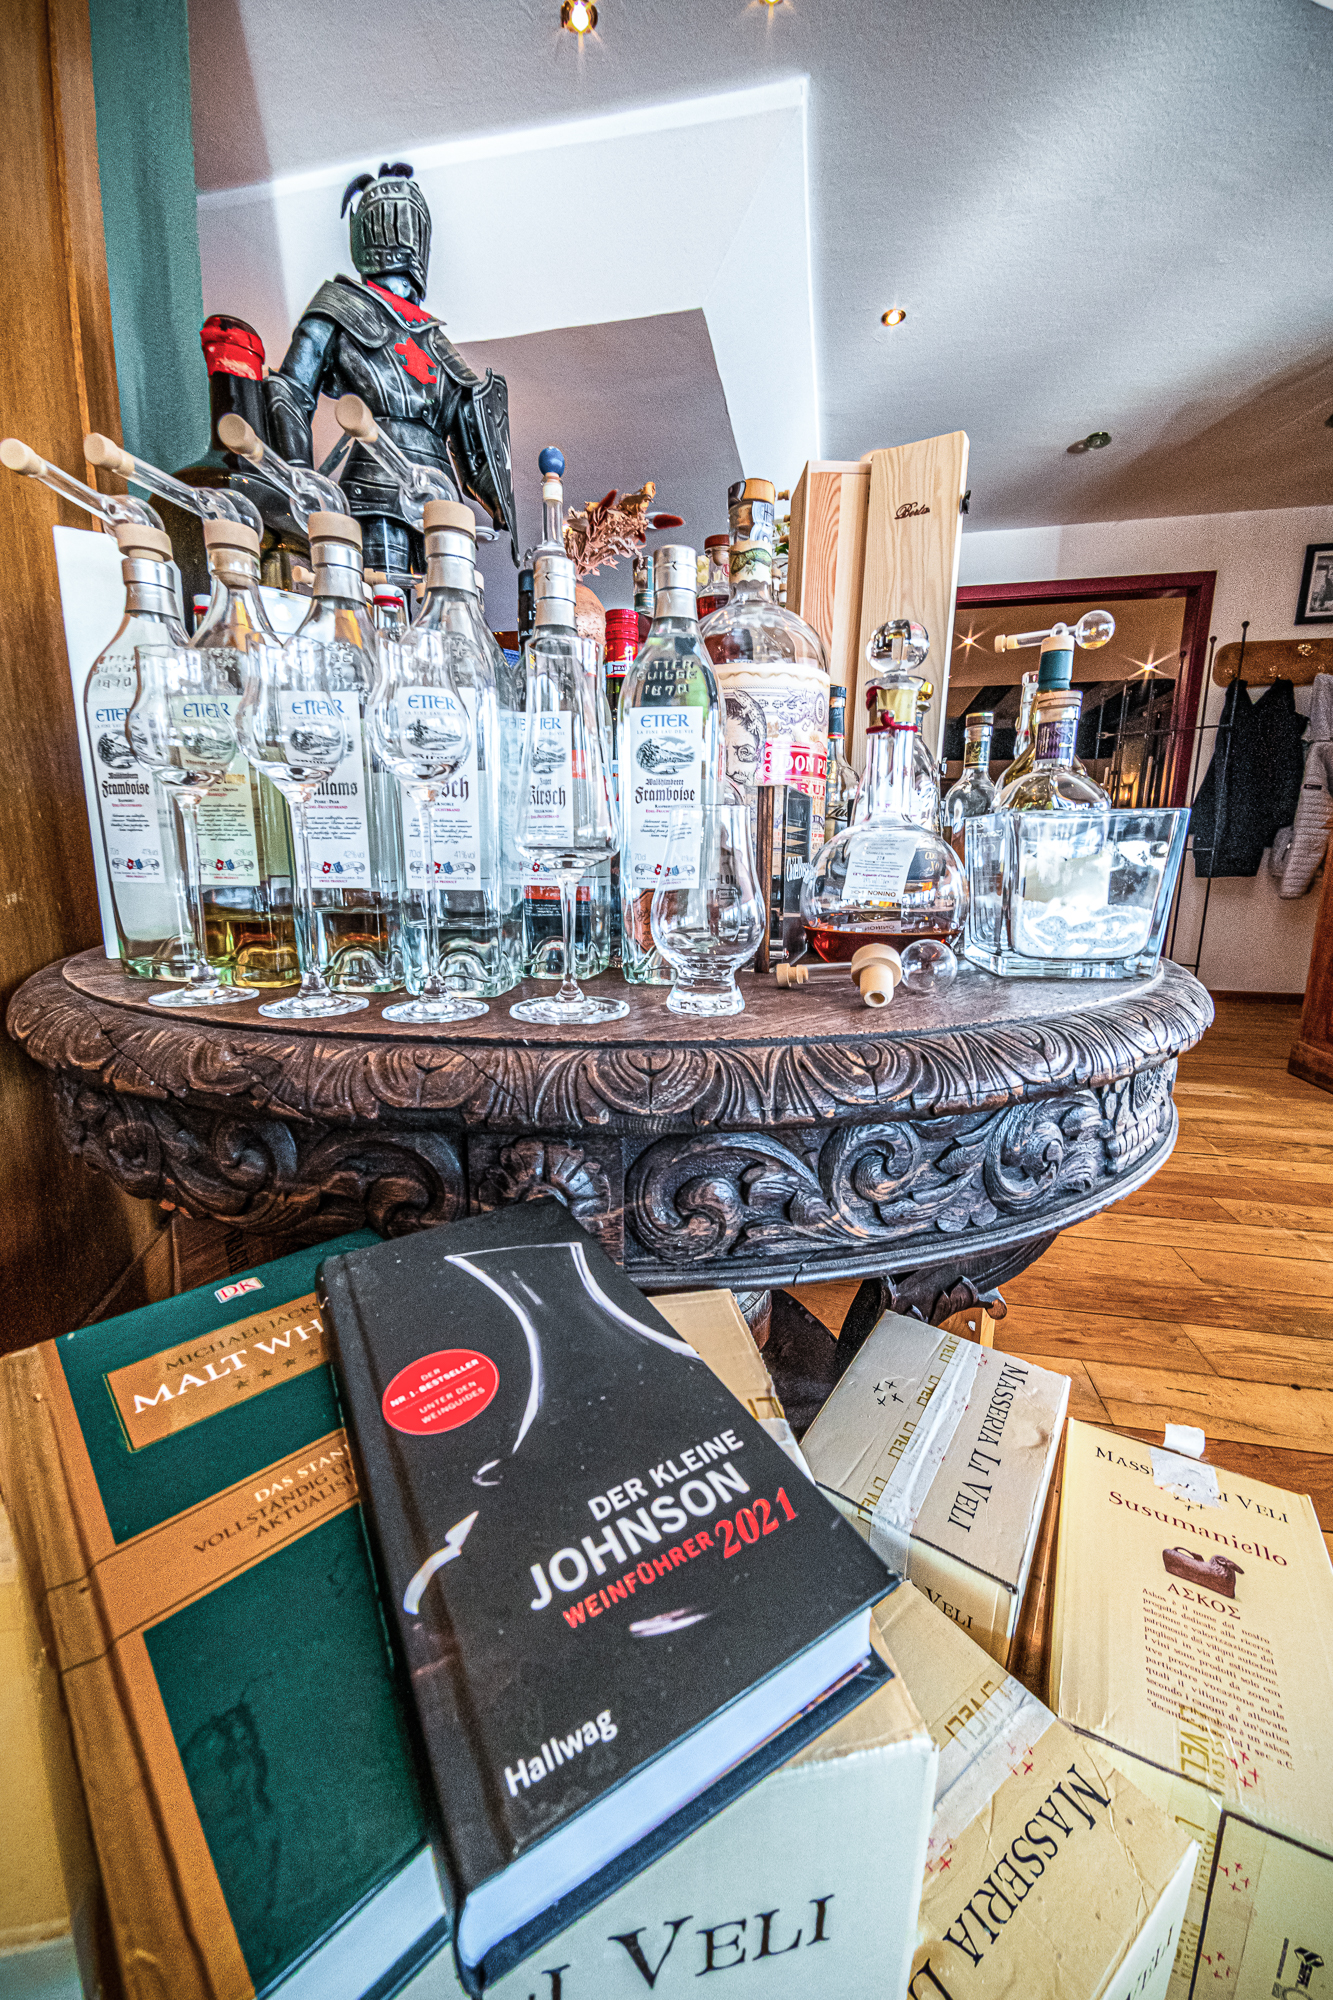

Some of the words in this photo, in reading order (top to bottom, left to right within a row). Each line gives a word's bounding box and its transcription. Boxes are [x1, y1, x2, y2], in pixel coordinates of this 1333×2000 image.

[408, 695, 457, 711] ETTER
[640, 713, 689, 728] ETTER
[101, 781, 151, 798] Framboise
[635, 786, 695, 804] Framboise
[867, 890, 897, 898] NONINO
[221, 1281, 257, 1298] DK
[165, 1326, 265, 1373] MICHAEL
[268, 1301, 321, 1330] JACKS
[133, 1350, 249, 1414] MALT
[254, 1319, 324, 1355] WH
[420, 1367, 441, 1382] DER
[419, 1392, 454, 1414] UNTER
[455, 1381, 477, 1395] DEN
[421, 1386, 486, 1424] WEINGUIDES
[977, 1362, 1029, 1447] MASSERIA
[587, 1477, 648, 1521] DER
[648, 1429, 744, 1488] KLEINE
[967, 1448, 1002, 1477] LI
[254, 1474, 293, 1503] DAS
[947, 1480, 993, 1533] VELI
[1235, 1493, 1289, 1524] VELI
[530, 1461, 750, 1611] JOHNSON
[1109, 1490, 1288, 1567] Susumaniello
[562, 1531, 715, 1629] WEINFÜHRER
[714, 1487, 798, 1559] 2021
[924, 1586, 974, 1630] VELI
[1143, 1588, 1166, 1602] Askos
[1193, 1609, 1216, 1623] nome
[1241, 1629, 1270, 1645] nostro
[1144, 1616, 1188, 1639] patrimonio
[1181, 1613, 1217, 1631] dedicato
[1220, 1630, 1236, 1639] alla
[1144, 1626, 1177, 1644] pugliesi
[1197, 1648, 1210, 1658] via
[1145, 1645, 1163, 1657] uve
[1168, 1655, 1222, 1683] provenienti
[1247, 1690, 1270, 1704] zone
[1146, 1656, 1198, 1683] particolare
[1203, 1681, 1254, 1708] vocazione
[1151, 1638, 1170, 1650] vini
[1174, 1648, 1195, 1661] sono
[1241, 1676, 1260, 1689] solo
[1263, 1686, 1281, 1698] con
[1145, 1666, 1170, 1681] quali
[1248, 1712, 1288, 1733] allevato
[1146, 1677, 1182, 1697] secondo
[1192, 1698, 1225, 1717] canoni
[504, 1709, 618, 1797] Hallwag
[942, 1764, 1111, 1968] MASSERIA
[607, 1894, 835, 1990] VELI
